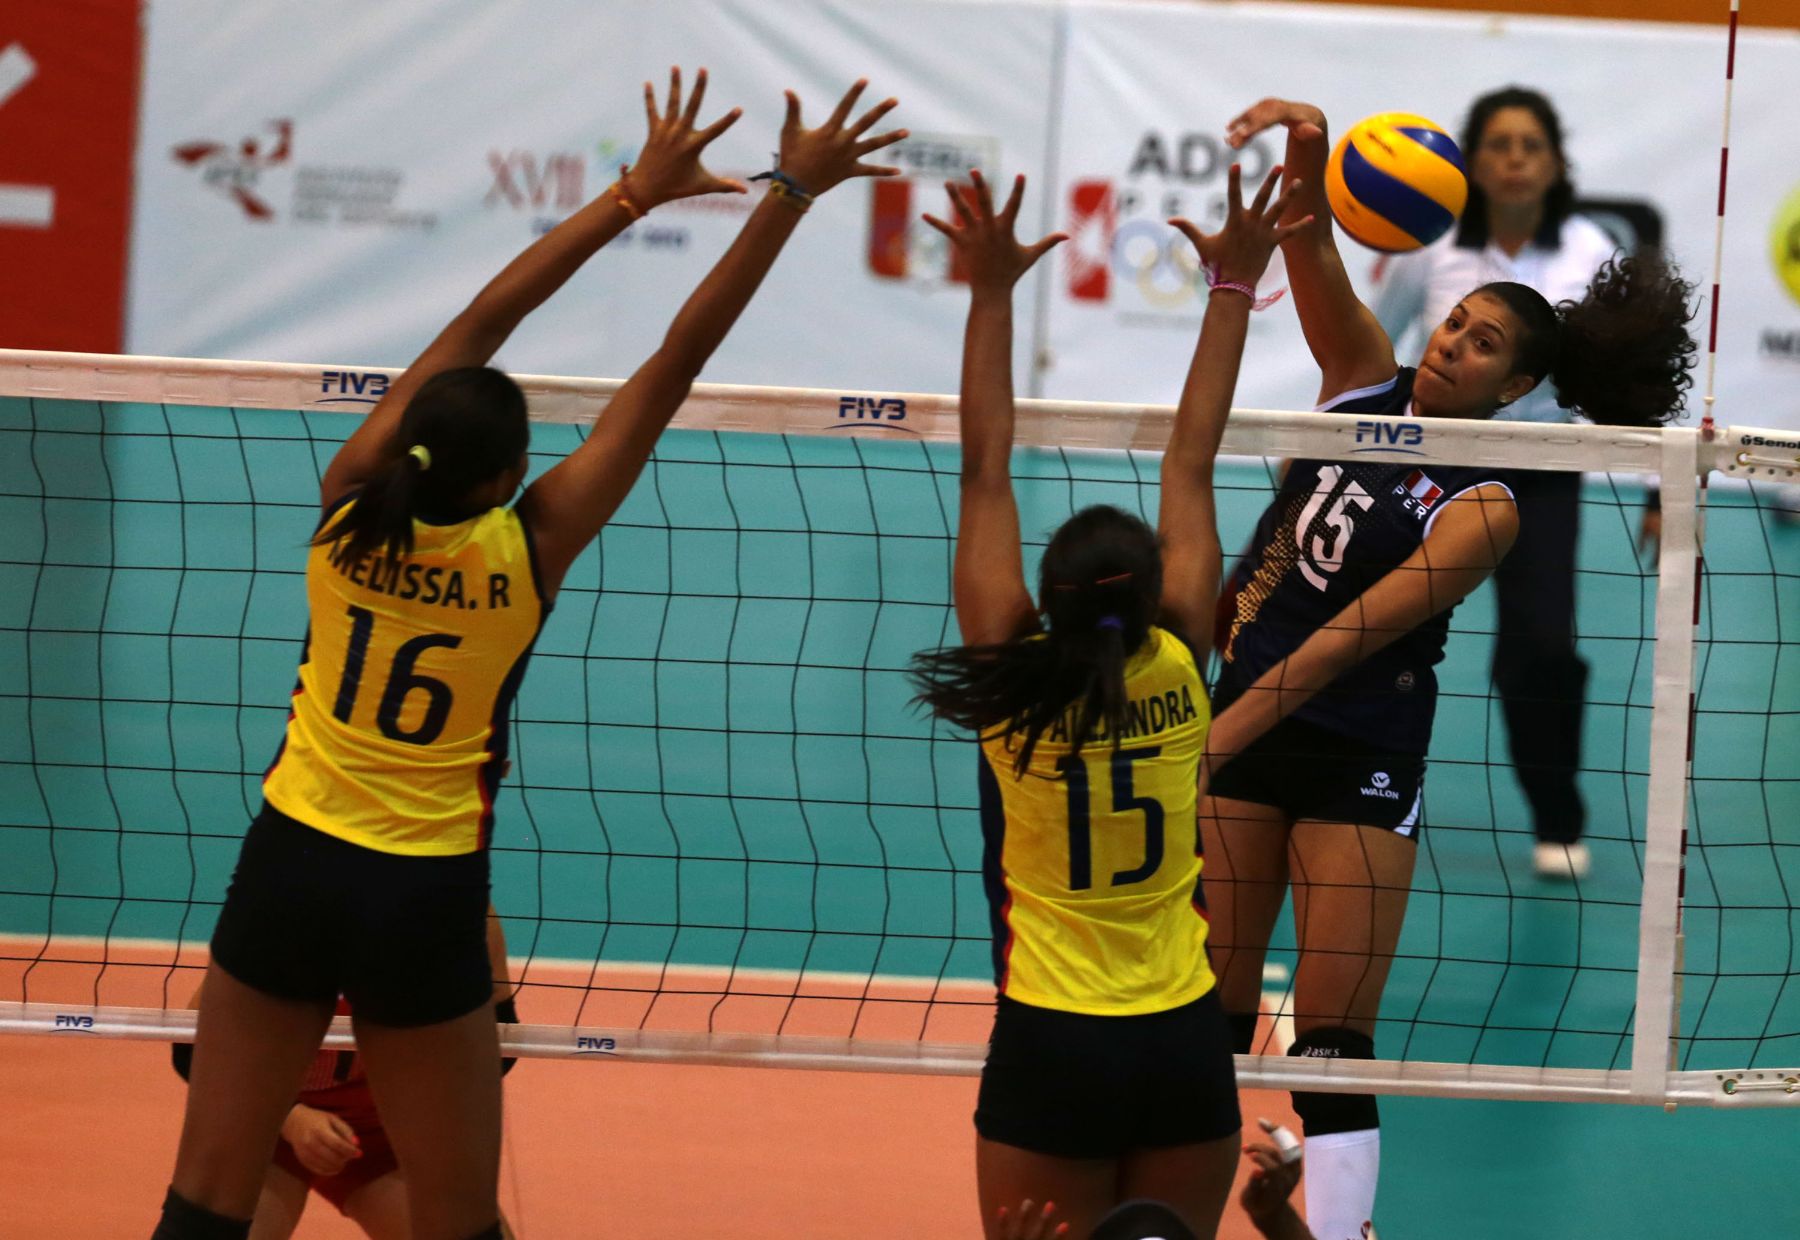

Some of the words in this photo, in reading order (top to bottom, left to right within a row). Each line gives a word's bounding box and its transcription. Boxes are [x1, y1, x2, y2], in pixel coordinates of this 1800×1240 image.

[1127, 128, 1272, 187] ADO
[321, 371, 390, 396] FIVB
[838, 396, 907, 421] FIVB
[1355, 421, 1424, 446] FIVB
[1296, 464, 1376, 593] 15
[488, 573, 511, 610] R
[332, 603, 464, 746] 16
[1360, 786, 1400, 800] WALON
[1055, 745, 1165, 892] 15
[55, 1014, 94, 1029] FIVB
[577, 1036, 616, 1050] FIVB
